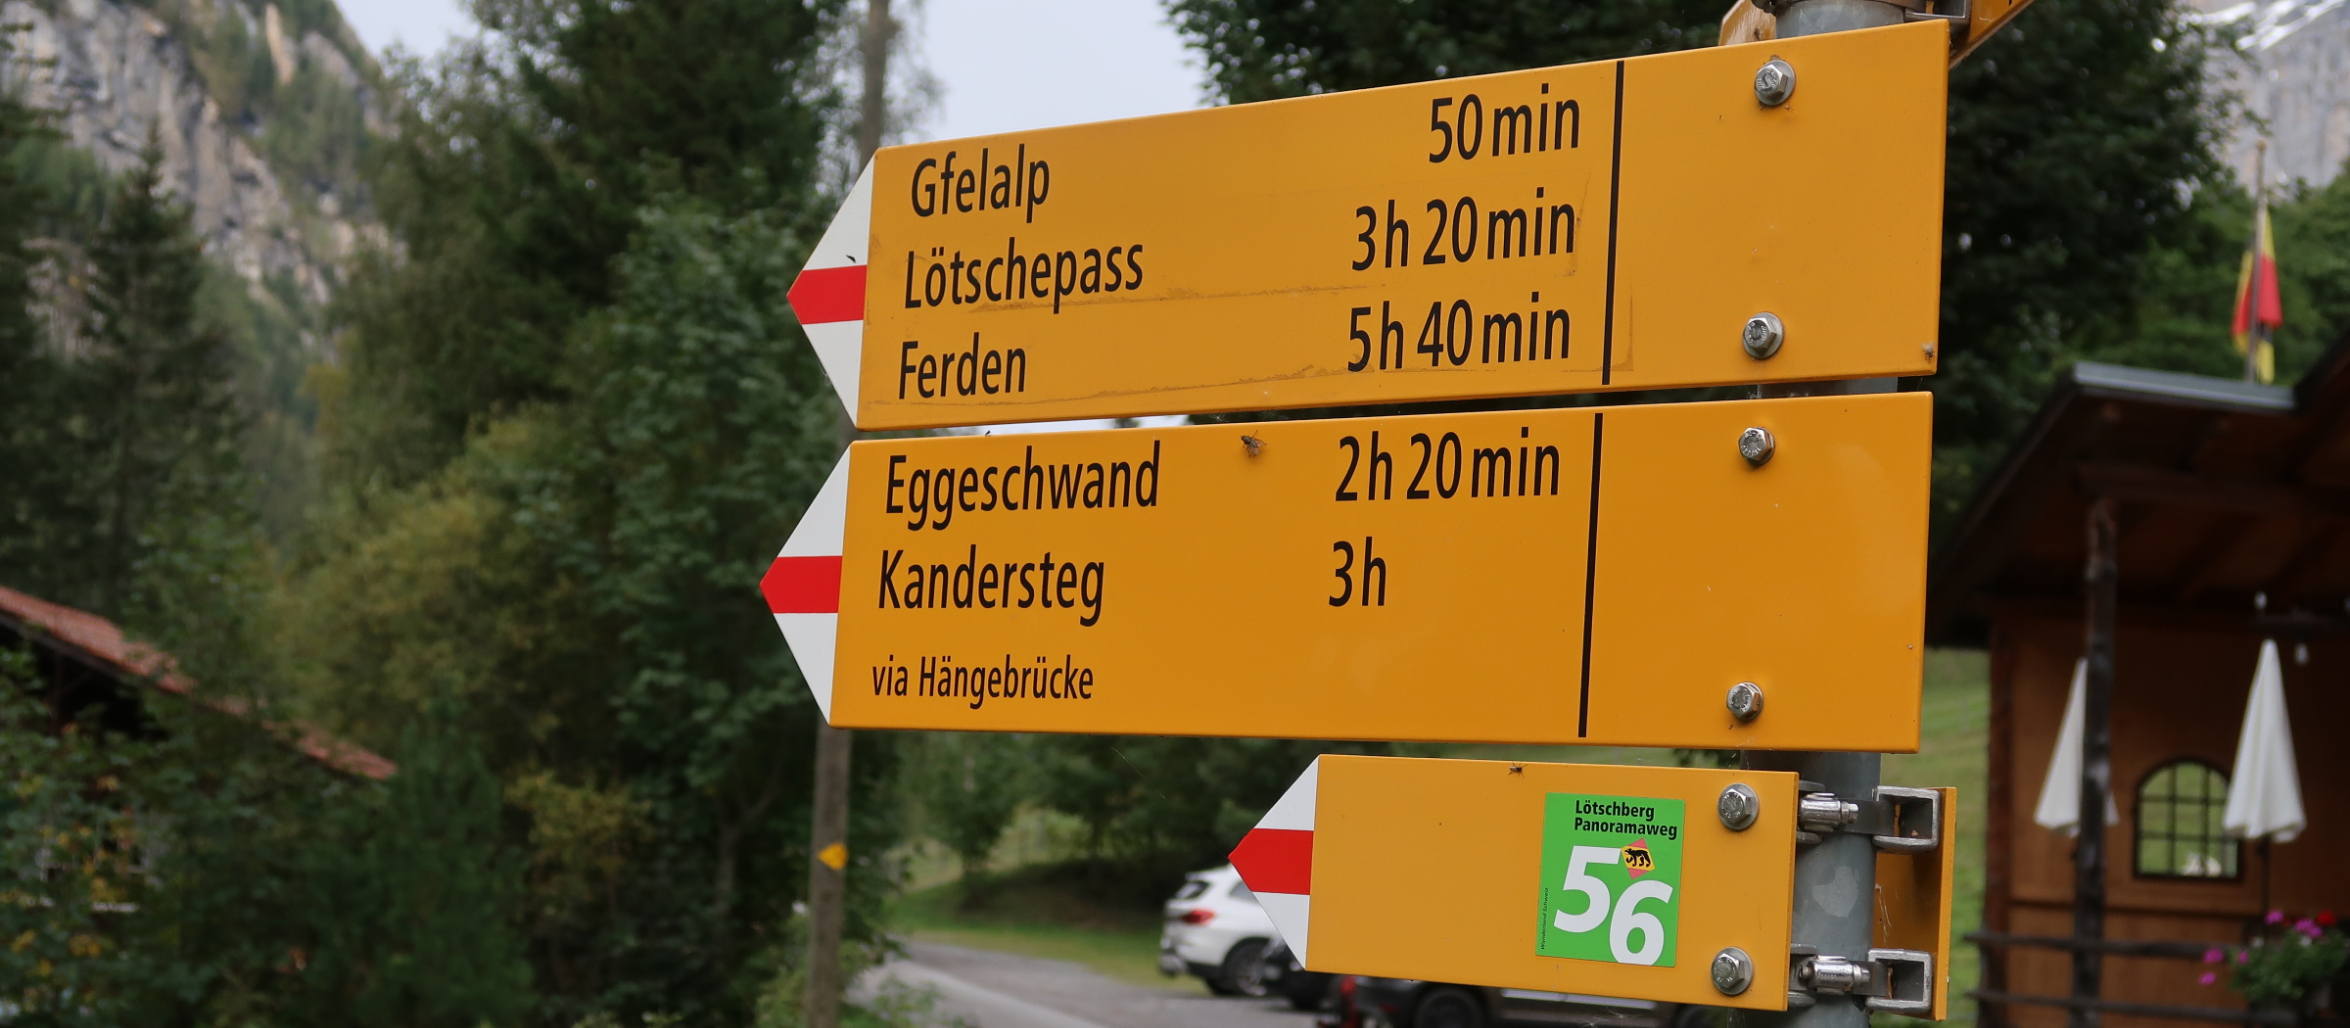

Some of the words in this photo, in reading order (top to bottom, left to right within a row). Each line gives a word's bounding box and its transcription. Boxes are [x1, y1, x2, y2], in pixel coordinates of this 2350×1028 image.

[912, 144, 1049, 223] Gfelalp
[905, 237, 1142, 314] Lötschepass
[899, 332, 1025, 399] Ferden
[886, 437, 1160, 531] Eggeschwand
[879, 544, 1104, 627] Kandersteg
[873, 655, 907, 696] via
[920, 654, 1093, 709] Hängebrücke
[1574, 816, 1678, 841] Panoramaweg
[1575, 799, 1655, 822] Lötschberg
[1553, 845, 1674, 966] 56
